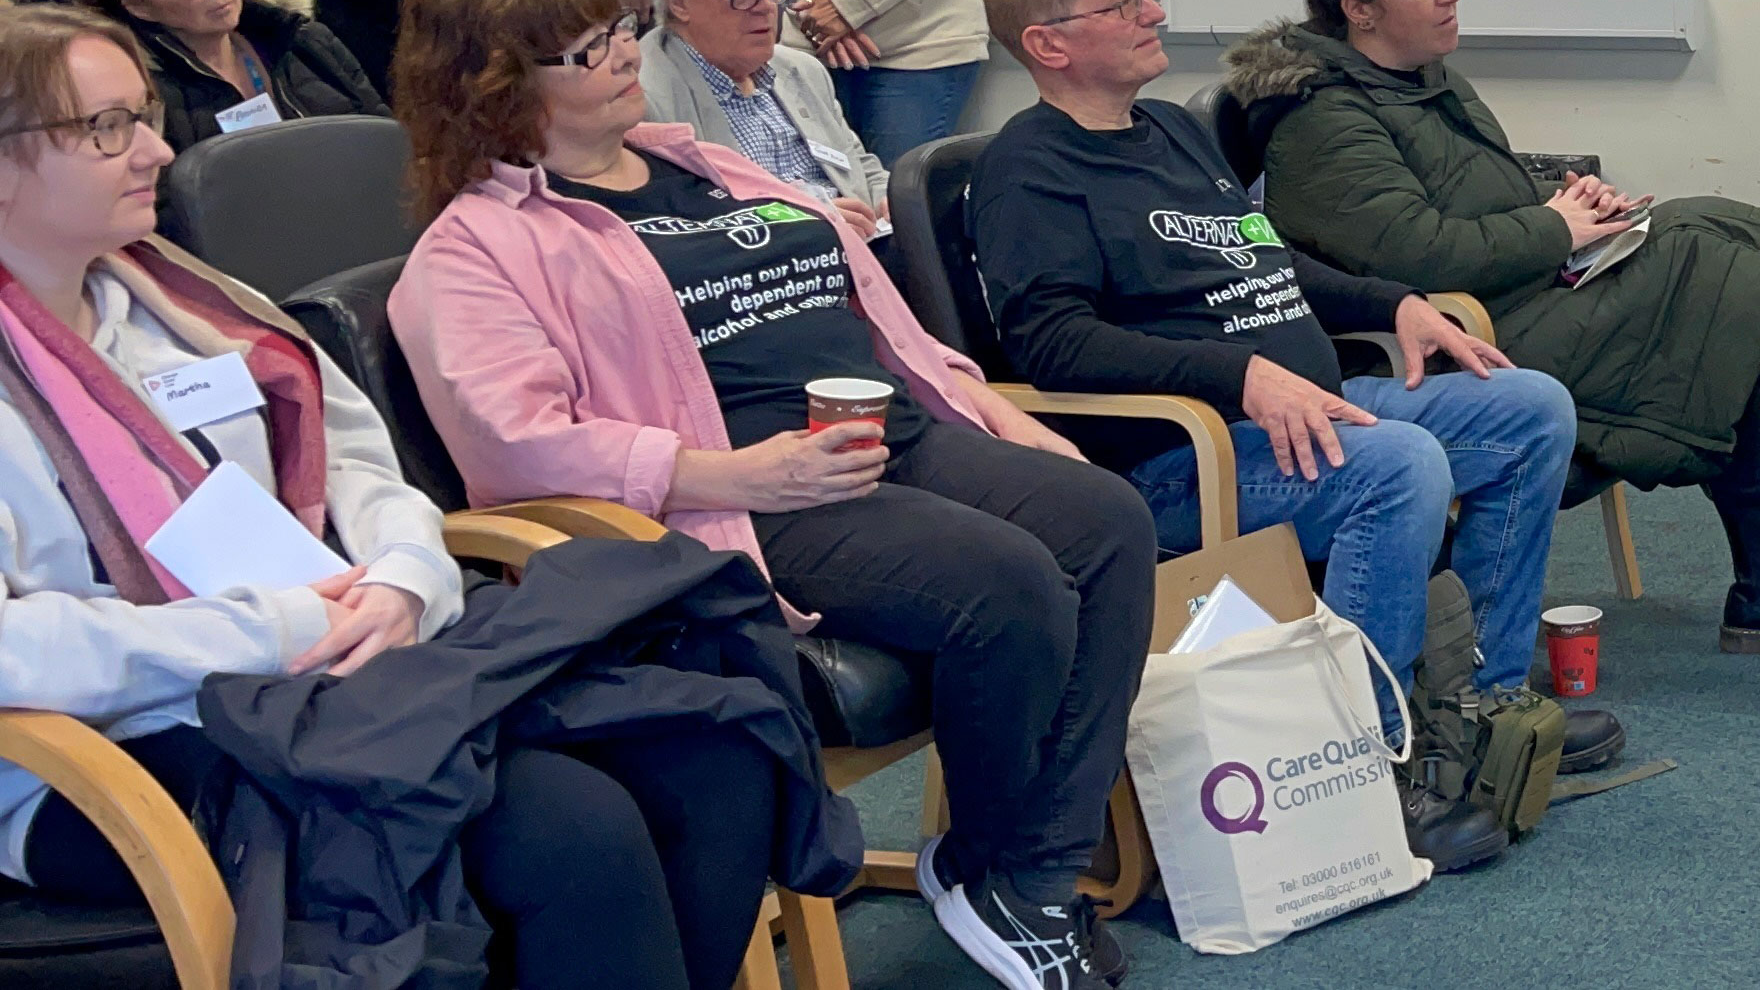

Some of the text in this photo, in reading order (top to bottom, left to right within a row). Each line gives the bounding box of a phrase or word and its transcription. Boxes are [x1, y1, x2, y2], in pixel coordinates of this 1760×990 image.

[675, 273, 753, 308] Helping
[757, 264, 789, 284] our
[791, 246, 840, 274] loved
[730, 274, 823, 314] dependent
[825, 273, 845, 290] on
[1205, 276, 1272, 308] Helping
[1267, 270, 1285, 286] our
[692, 312, 763, 349] alcohol
[763, 302, 801, 322] and
[1223, 307, 1285, 334] alcohol
[1284, 302, 1302, 321] and
[1266, 752, 1322, 782] Care
[1279, 851, 1381, 894] Tel: 03000 616161
